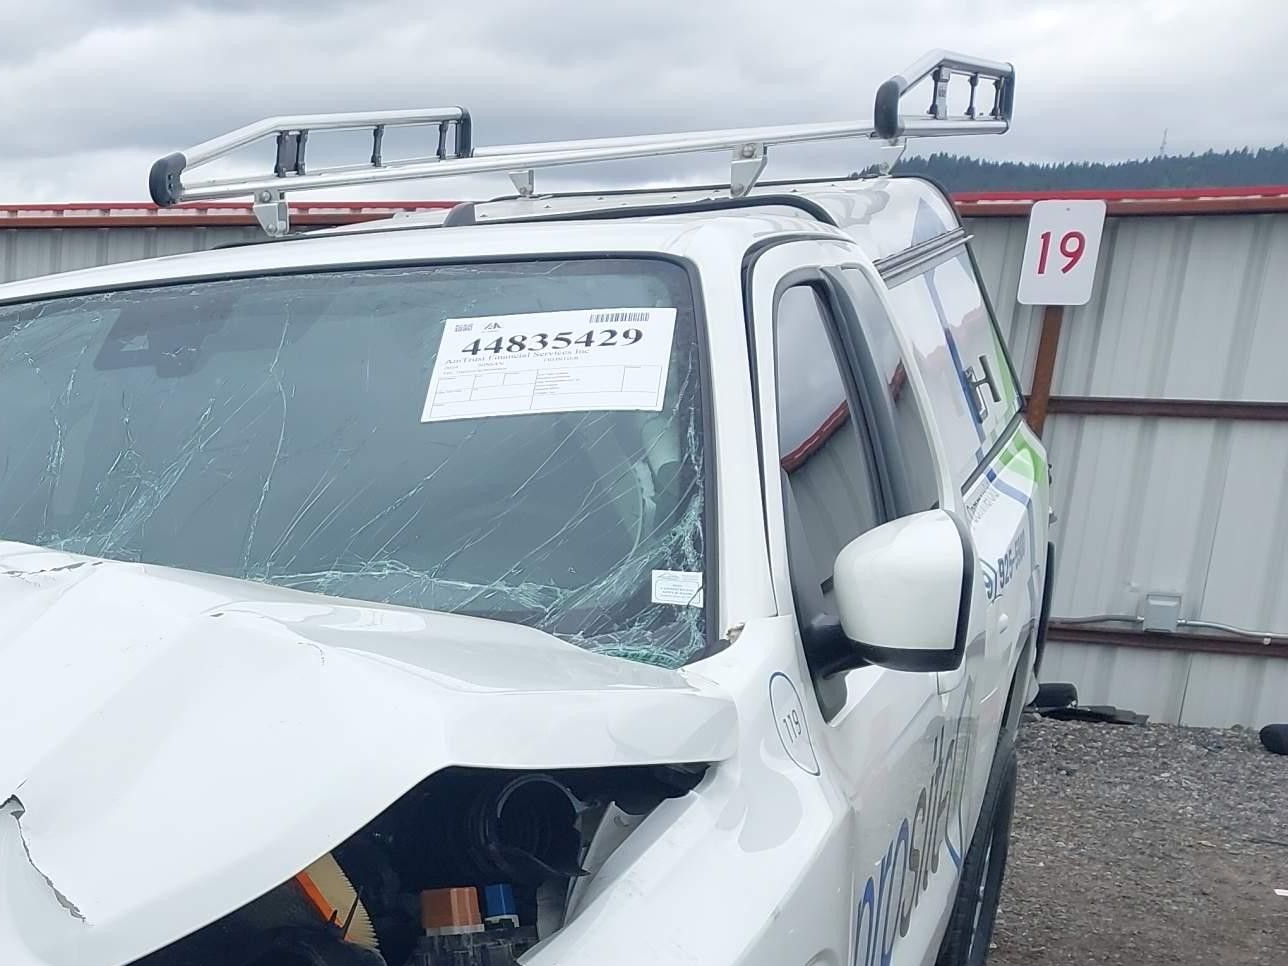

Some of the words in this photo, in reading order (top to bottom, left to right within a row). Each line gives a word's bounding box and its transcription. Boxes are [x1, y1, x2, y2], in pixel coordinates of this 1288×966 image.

[1038, 231, 1086, 274] 19
[461, 328, 643, 355] 44835429
[488, 352, 530, 361] Financial
[533, 349, 572, 358] Services
[783, 709, 802, 744] 119
